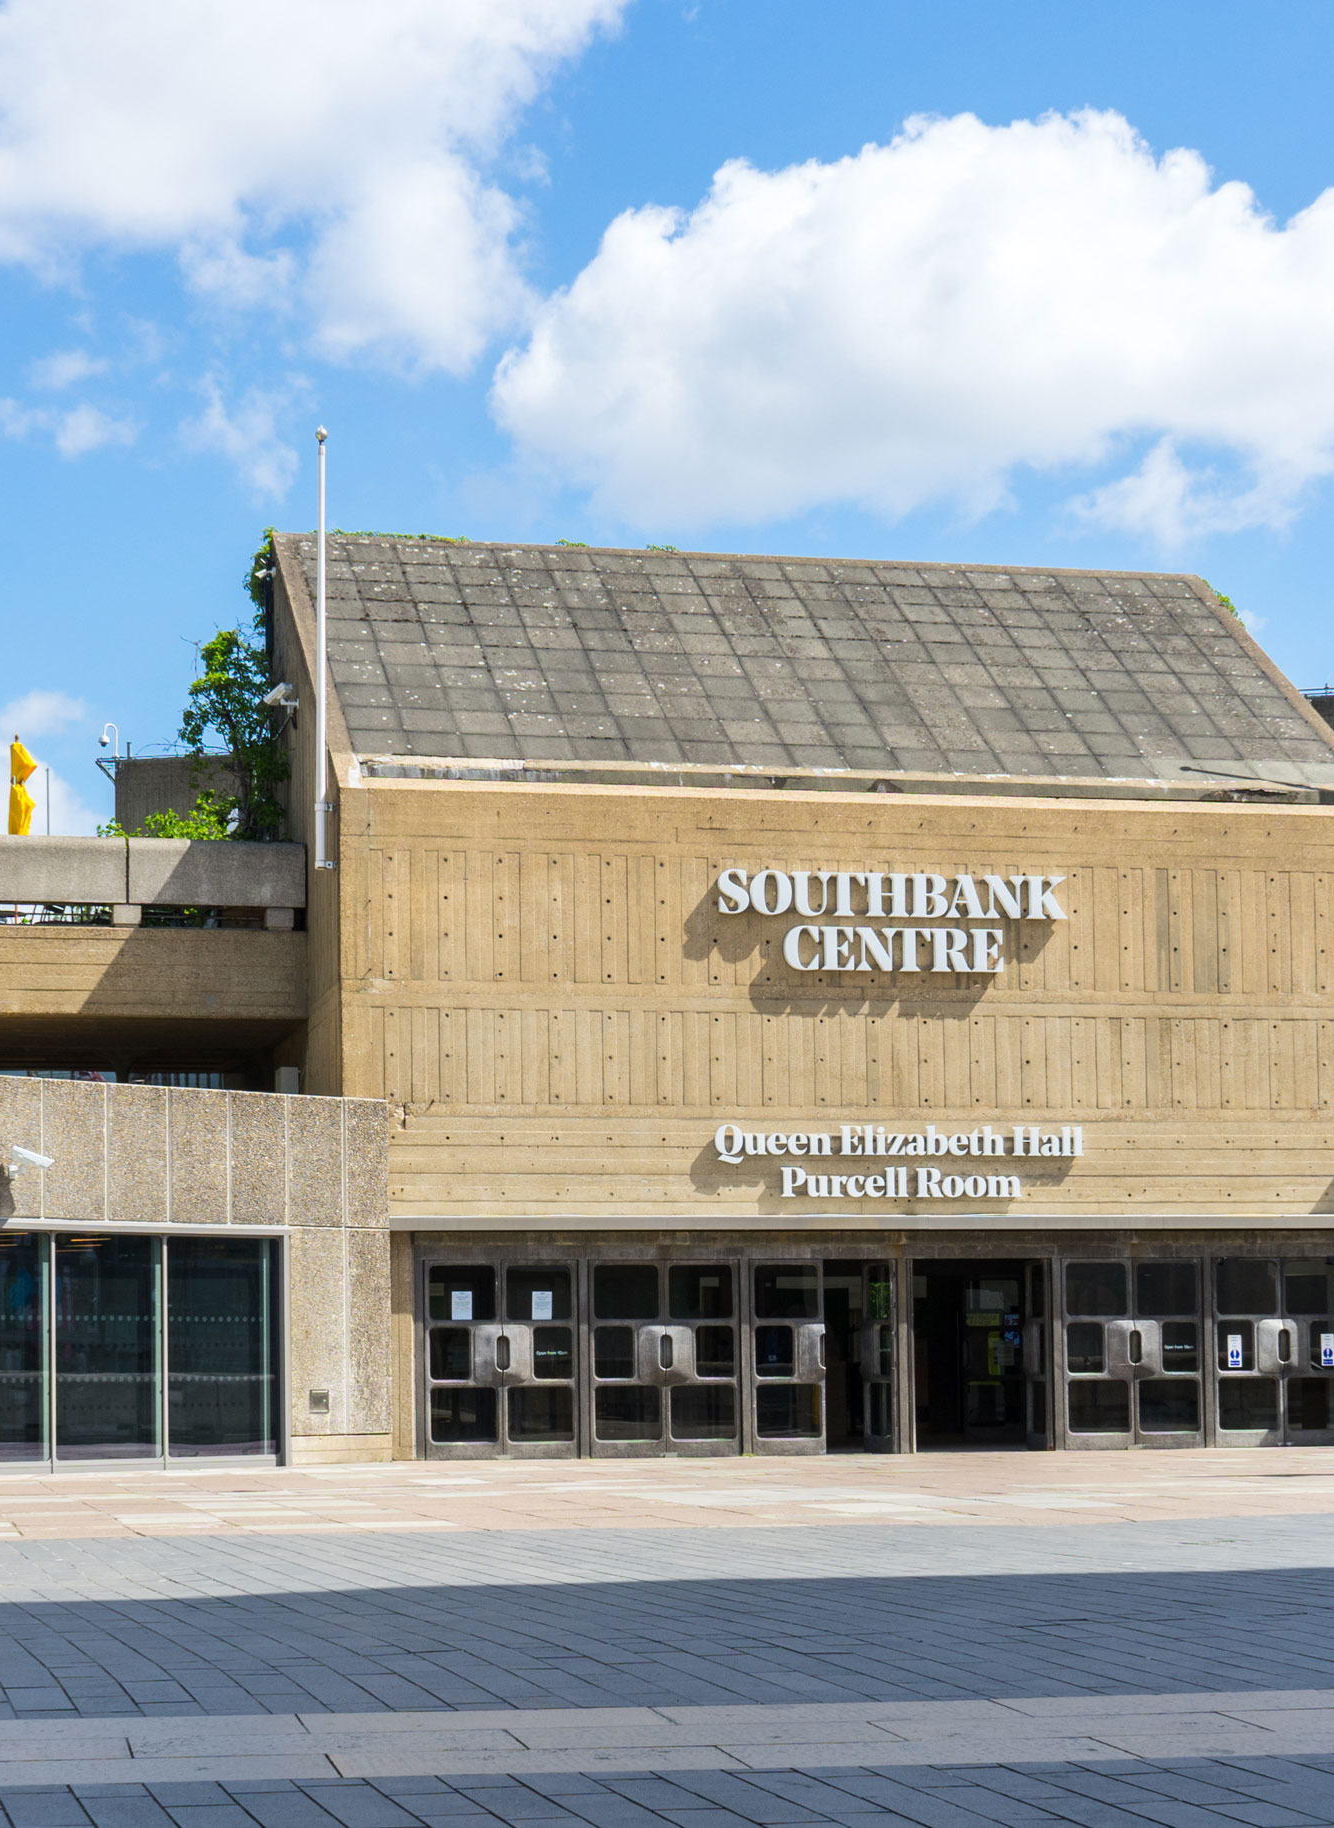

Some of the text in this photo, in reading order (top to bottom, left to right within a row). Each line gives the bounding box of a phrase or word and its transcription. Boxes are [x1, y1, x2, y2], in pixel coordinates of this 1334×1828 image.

[717, 868, 1068, 920] SOUTHBANK
[783, 925, 1004, 973] CENTRE
[715, 1124, 1084, 1164] Queen Elizabeth Hall
[780, 1166, 1022, 1198] Purcell Room
